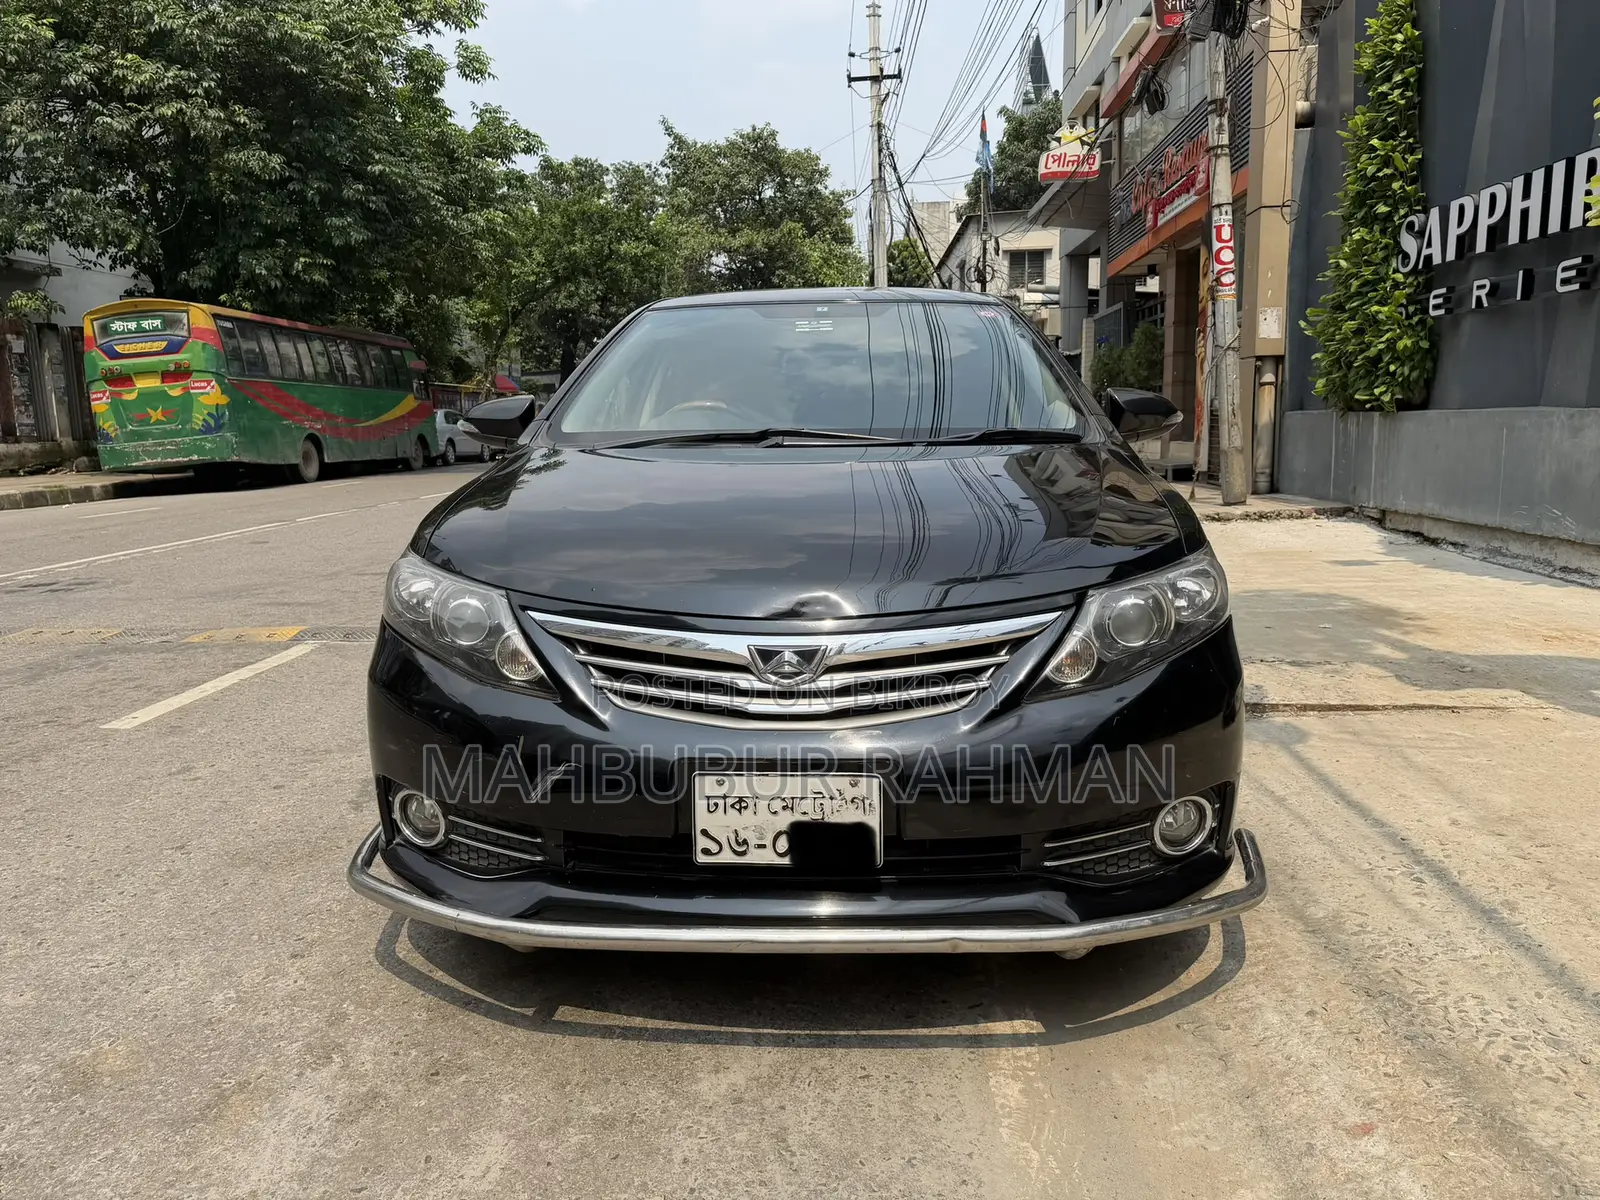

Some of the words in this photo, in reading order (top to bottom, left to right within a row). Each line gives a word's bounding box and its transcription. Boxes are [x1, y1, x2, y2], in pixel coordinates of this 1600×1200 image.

[1398, 256, 1582, 318] ERIE
[110, 320, 138, 333] স্টাফ
[139, 318, 162, 330] বাস
[704, 794, 760, 817] ঢাকা
